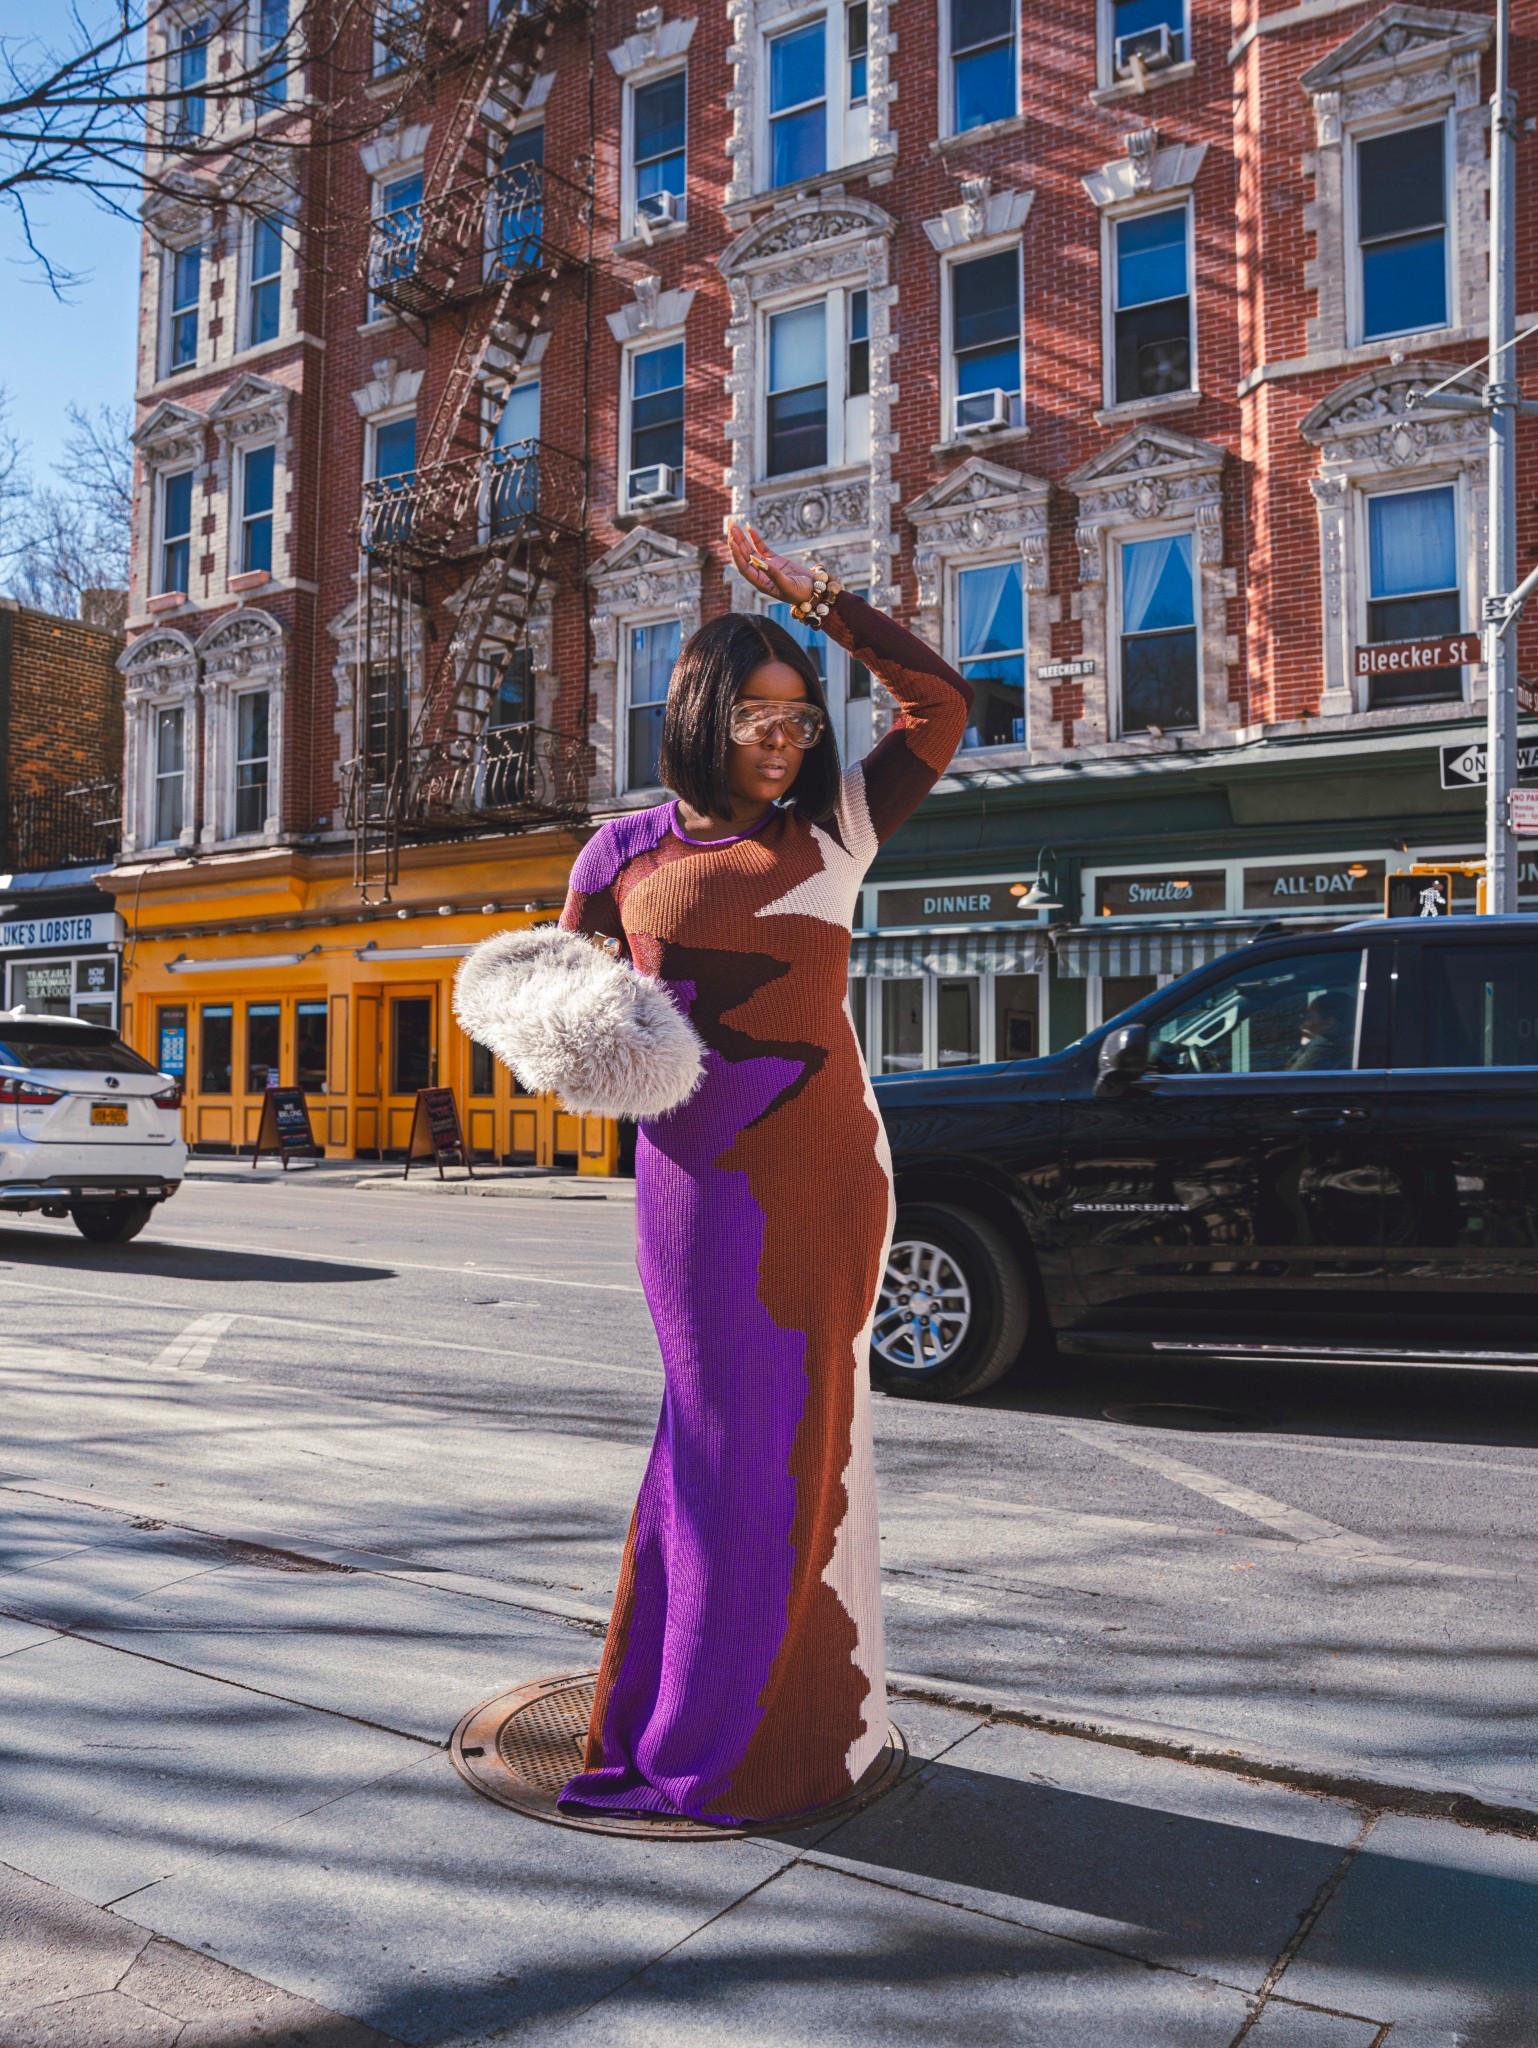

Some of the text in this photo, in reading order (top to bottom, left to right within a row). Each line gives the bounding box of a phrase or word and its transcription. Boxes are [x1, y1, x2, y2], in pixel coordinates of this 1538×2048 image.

[1358, 646, 1441, 673] Bleecker
[1450, 641, 1468, 664] St
[1038, 661, 1094, 679] BLEECKER ST
[1514, 793, 1524, 802] NO
[1128, 881, 1193, 902] Smiles
[924, 894, 991, 914] DINNER
[0, 918, 92, 946] UKE'S LOBSTER
[88, 967, 105, 976] NOW
[88, 975, 105, 985] OPEN
[1072, 1203, 1190, 1212] SUBURBAN
